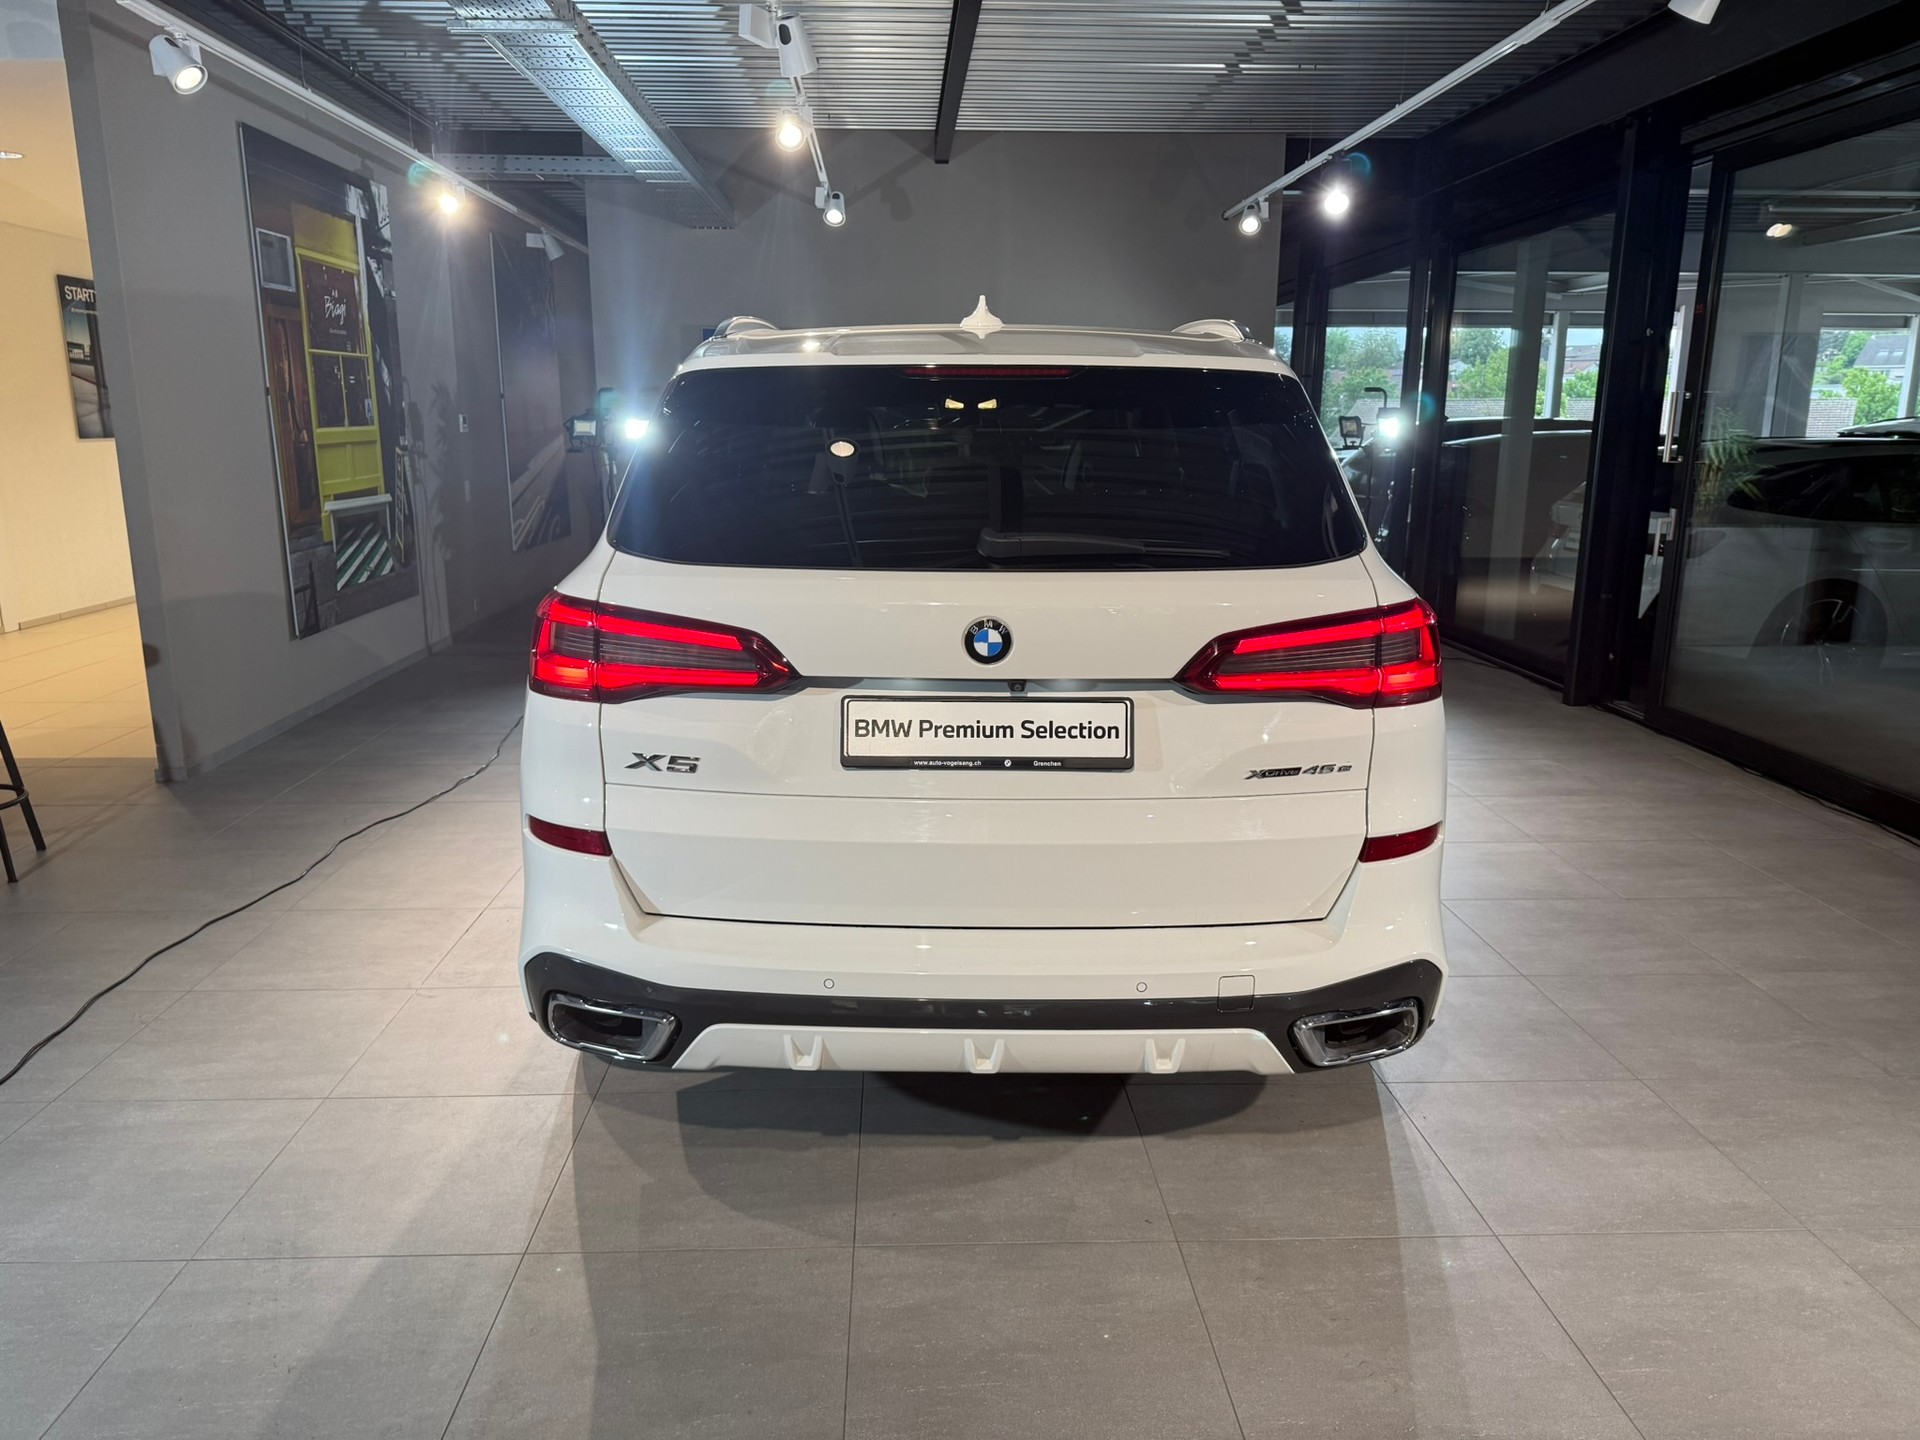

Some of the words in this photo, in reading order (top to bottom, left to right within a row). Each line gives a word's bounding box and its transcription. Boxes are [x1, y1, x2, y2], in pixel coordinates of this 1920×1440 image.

[854, 719, 913, 738] BMW
[918, 719, 1015, 739] Premium
[1020, 719, 1120, 739] Selection
[624, 752, 701, 774] X5
[913, 759, 982, 767] www.auto-vogelsang.ch
